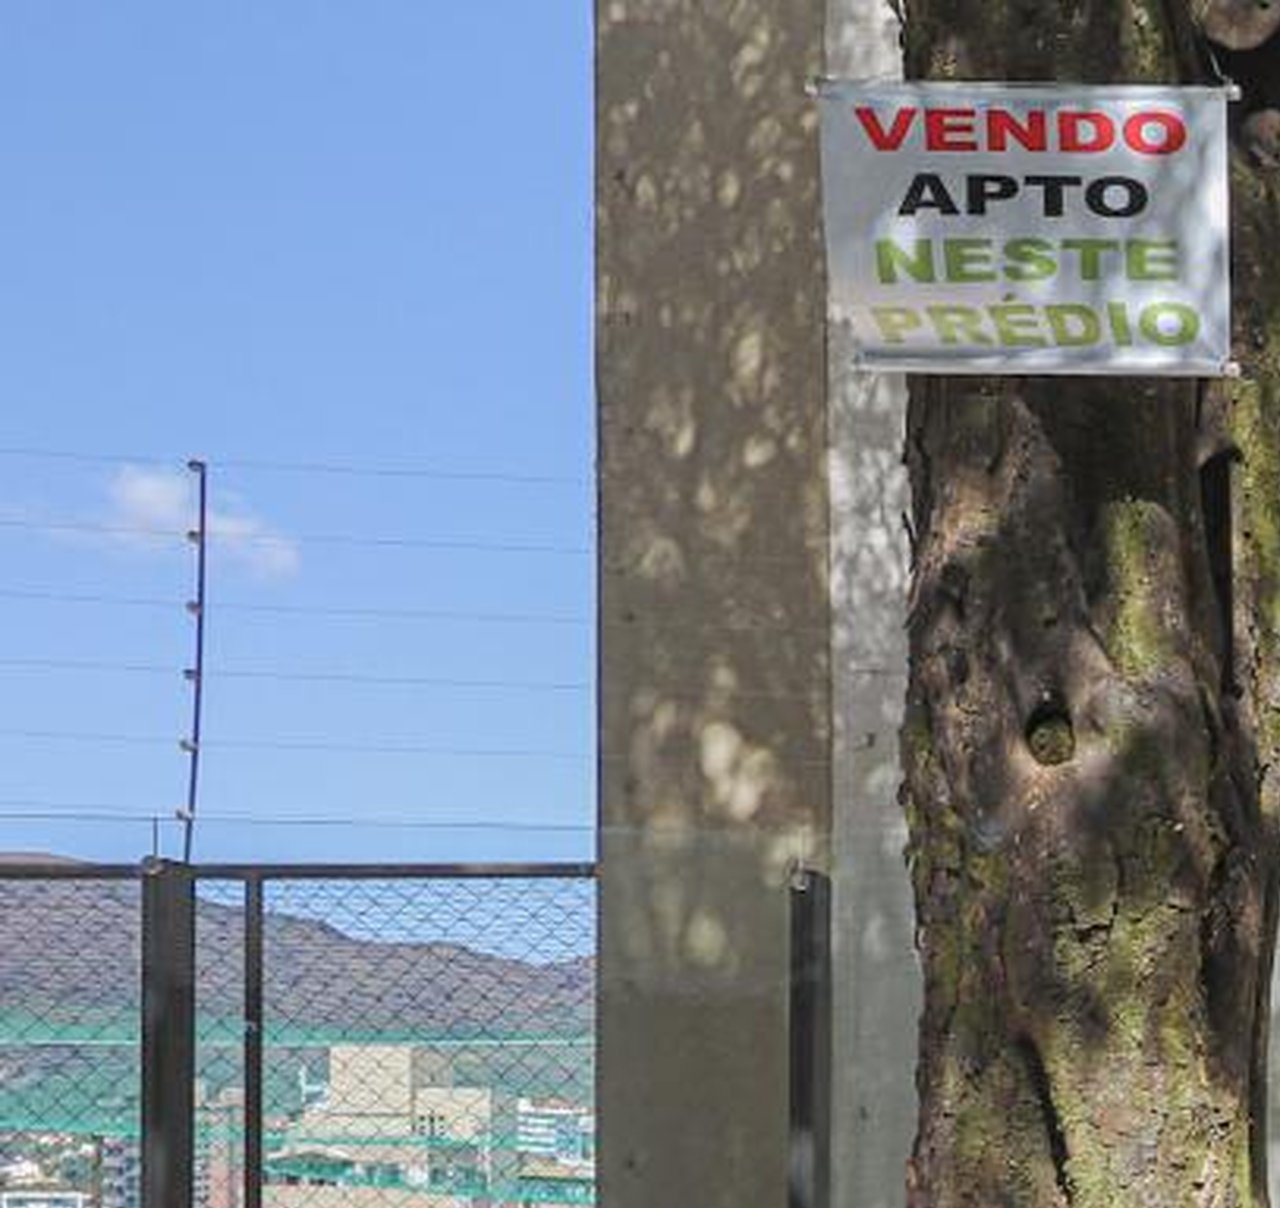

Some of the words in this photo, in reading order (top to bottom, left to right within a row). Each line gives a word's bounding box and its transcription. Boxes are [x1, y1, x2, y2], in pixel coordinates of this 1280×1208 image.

[854, 106, 1188, 155] VENDO
[897, 172, 1150, 218] APTO
[874, 237, 1181, 285] NESTE
[869, 292, 1202, 348] PRÉDIO
